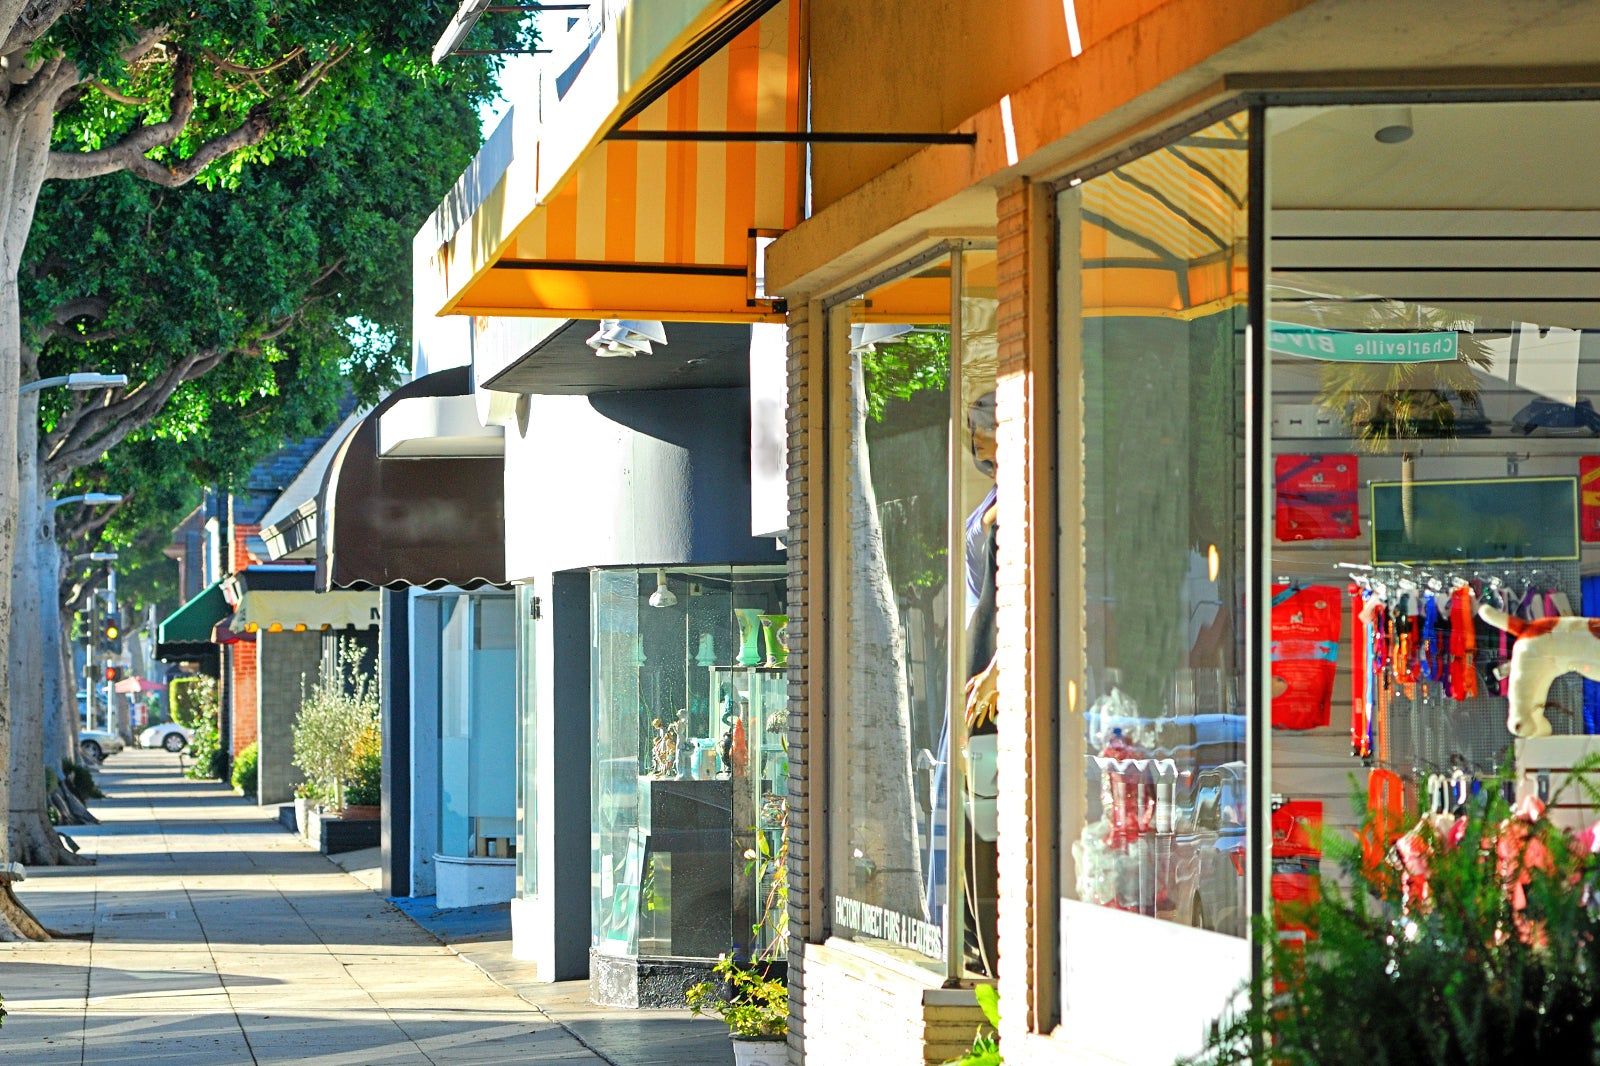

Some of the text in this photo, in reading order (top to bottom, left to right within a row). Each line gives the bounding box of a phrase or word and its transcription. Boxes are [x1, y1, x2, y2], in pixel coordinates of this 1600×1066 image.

[835, 895, 861, 931] FACTORY
[861, 902, 883, 938] DIRECT
[883, 908, 901, 945] FURS
[907, 917, 942, 960] LEATHERS
